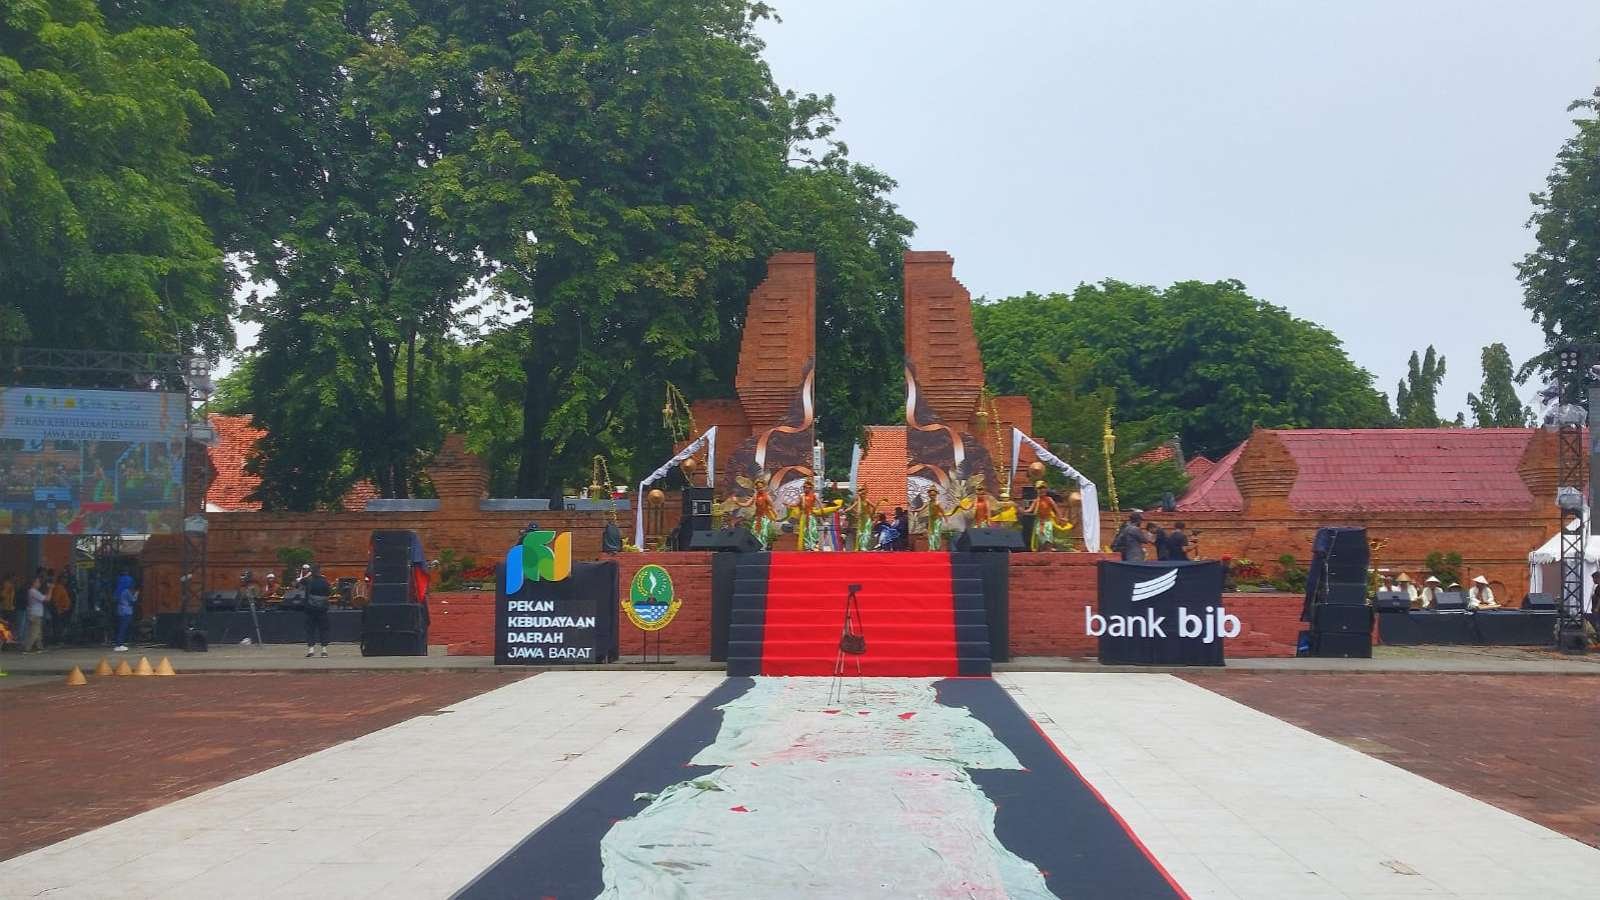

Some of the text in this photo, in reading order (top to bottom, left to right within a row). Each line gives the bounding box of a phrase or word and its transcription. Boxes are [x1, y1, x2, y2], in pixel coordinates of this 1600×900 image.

[508, 601, 554, 612] PEKAN
[508, 616, 595, 628] KEBUDAYAAN
[1085, 606, 1241, 644] bank bjb
[507, 632, 563, 643] DAERAH
[507, 647, 592, 659] JAWA BARAT
